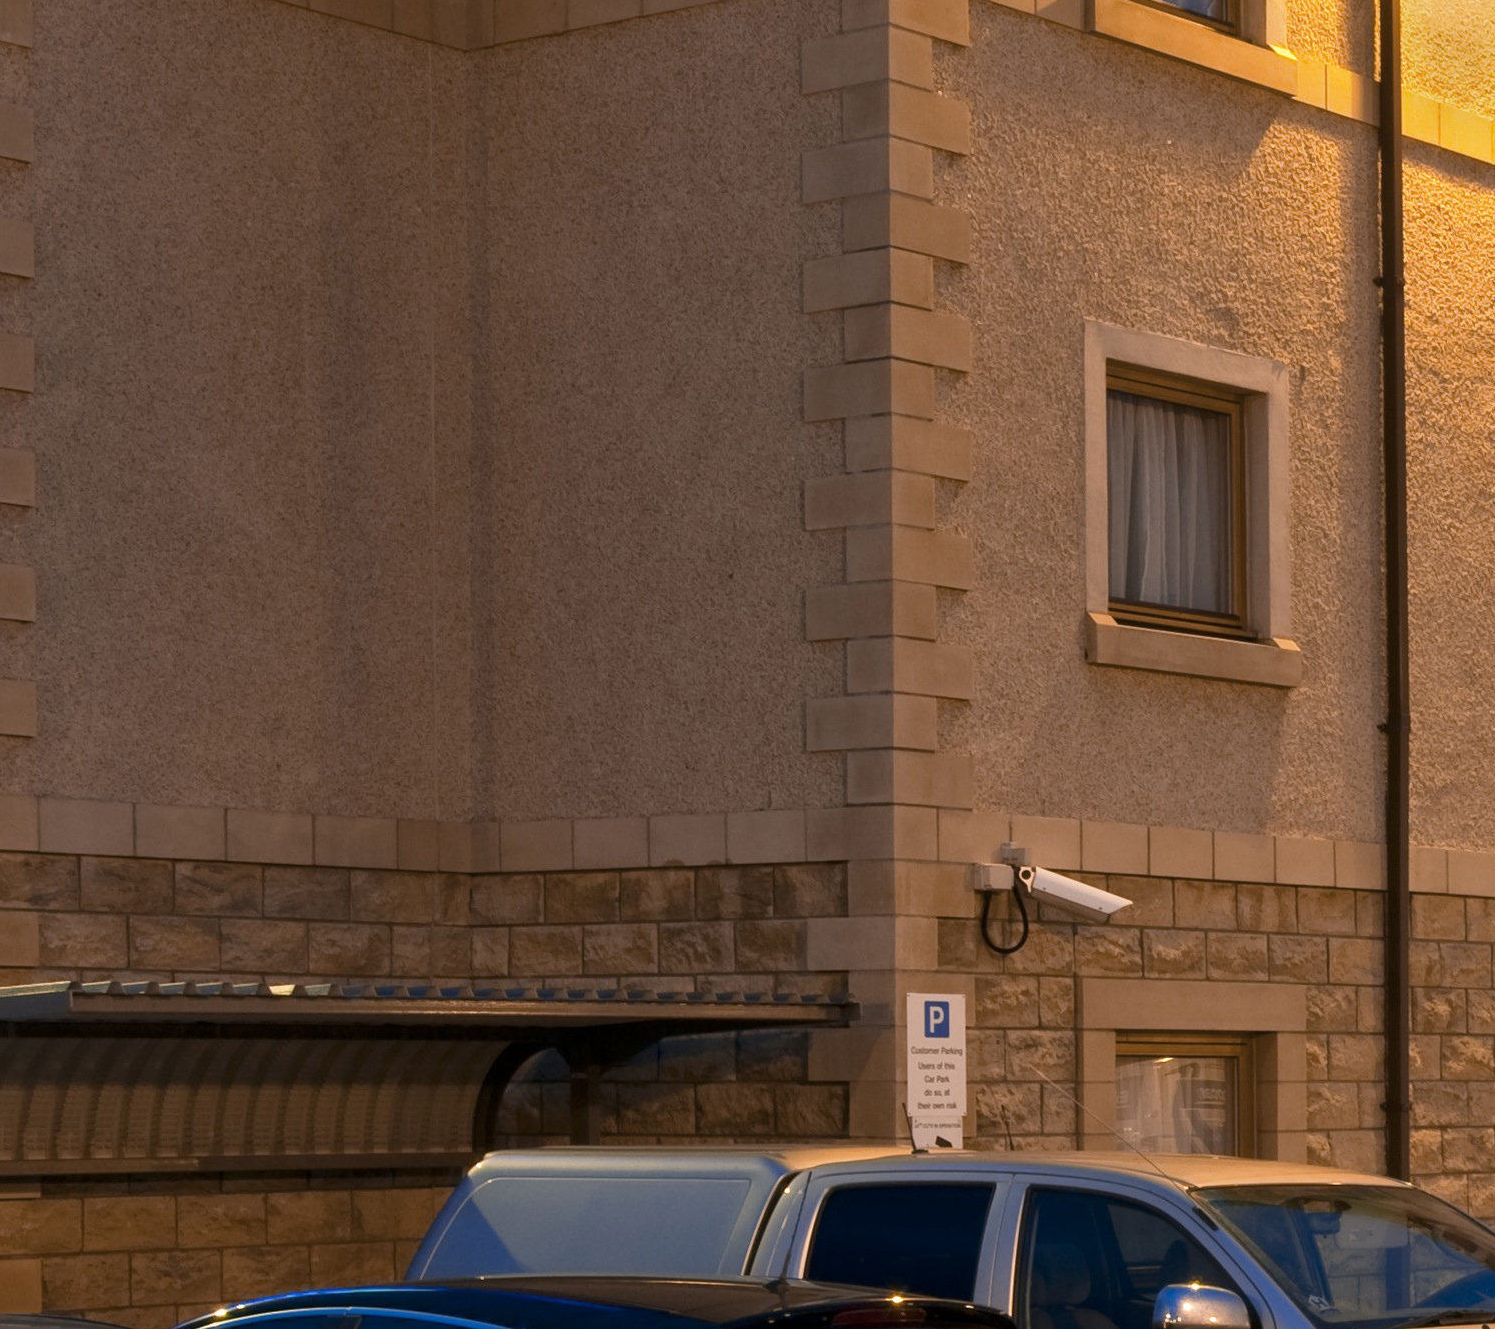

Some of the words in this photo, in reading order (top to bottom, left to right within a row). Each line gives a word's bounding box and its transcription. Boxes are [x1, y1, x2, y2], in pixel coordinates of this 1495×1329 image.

[929, 1006, 944, 1033] P
[910, 1046, 940, 1055] Customer
[941, 1046, 963, 1057] Parking
[918, 1061, 935, 1070] Users
[936, 1061, 943, 1070] of
[944, 1062, 955, 1070] this
[924, 1074, 935, 1083] Car
[936, 1074, 950, 1083] Park
[924, 1089, 933, 1097] do
[944, 1088, 950, 1096] at
[917, 1101, 931, 1110] their
[932, 1102, 945, 1110] own
[946, 1101, 957, 1110] risk
